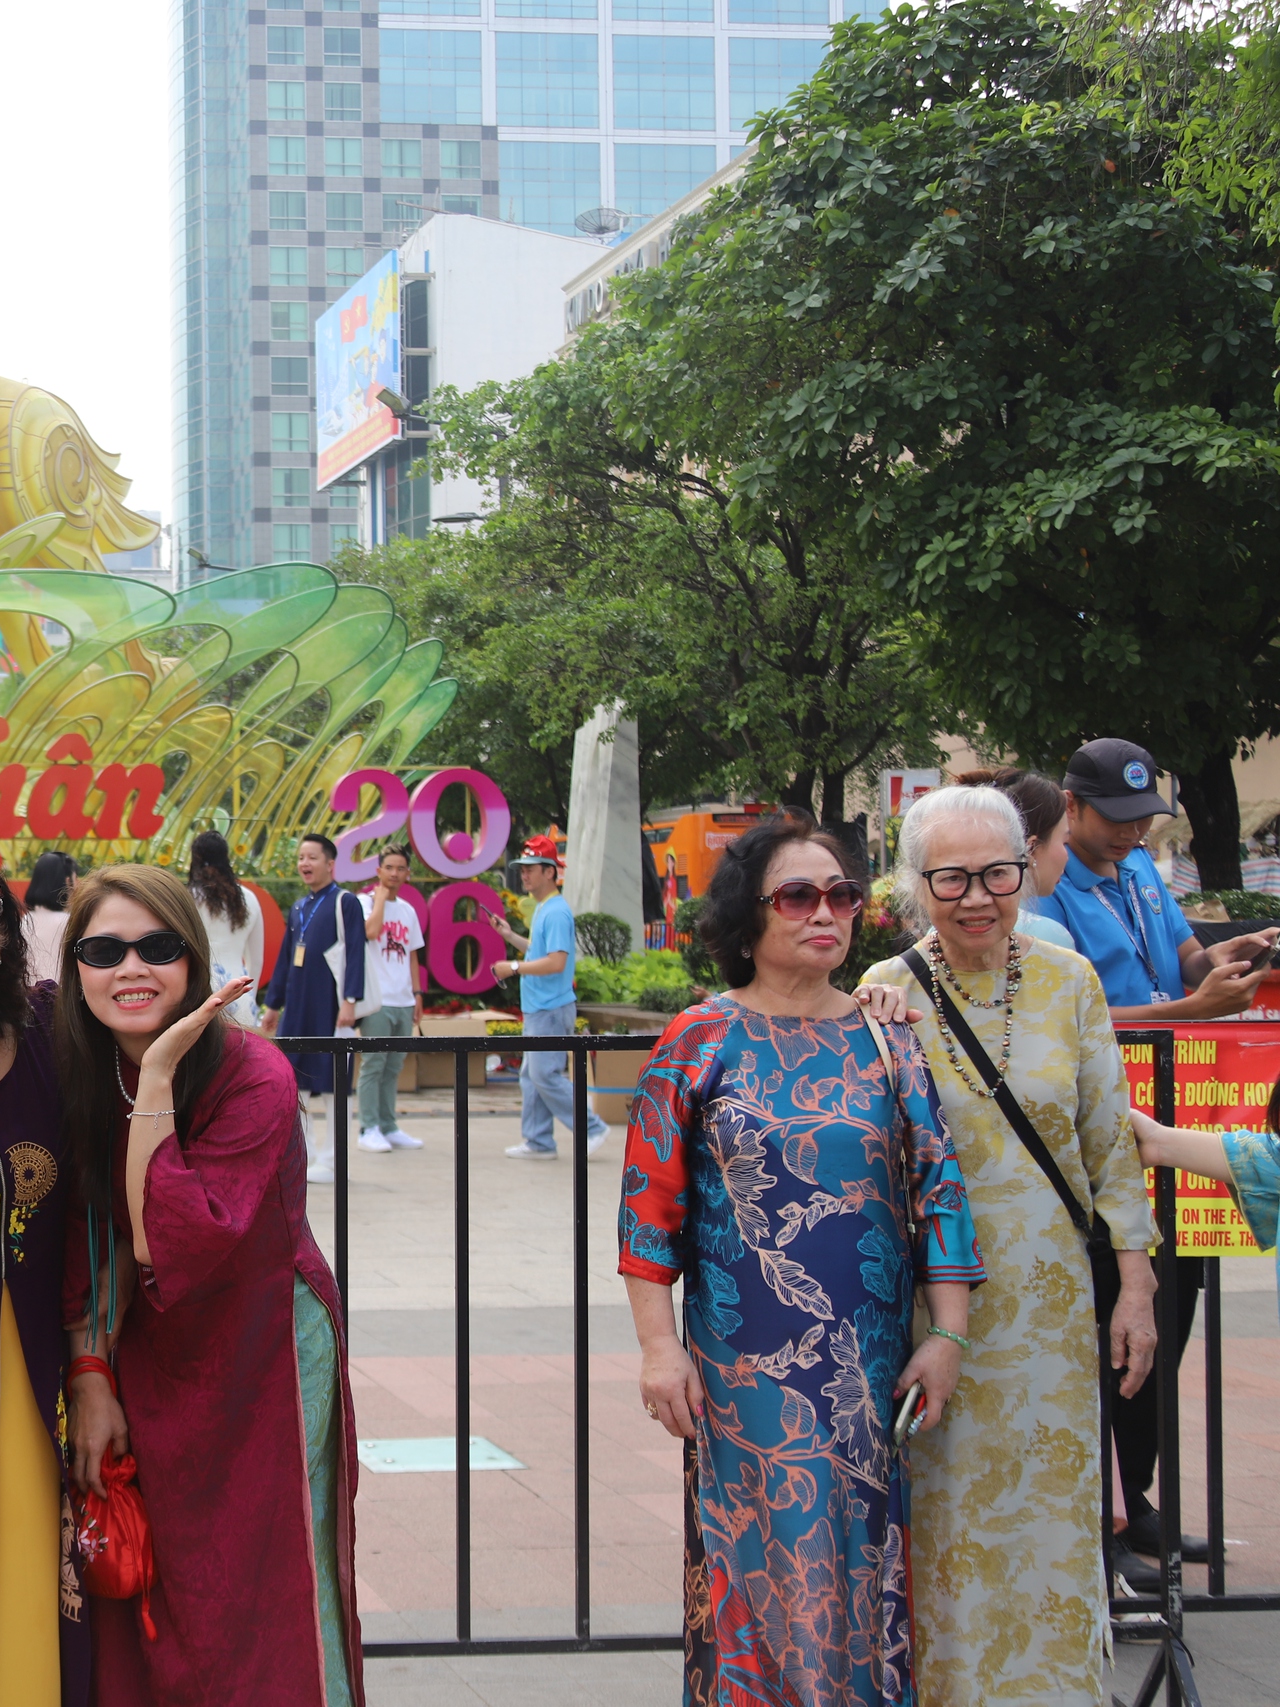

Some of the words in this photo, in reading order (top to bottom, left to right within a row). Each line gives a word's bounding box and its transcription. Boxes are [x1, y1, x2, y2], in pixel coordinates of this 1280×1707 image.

[331, 768, 511, 882] 20
[360, 881, 507, 995] 6
[1135, 1077, 1181, 1107] CÔG
[1184, 1077, 1240, 1107] ĐƯỜNG
[1182, 1208, 1200, 1225] ON
[1203, 1208, 1226, 1225] THE
[1230, 1208, 1244, 1225] FL
[1192, 1230, 1235, 1247] ROUTE.
